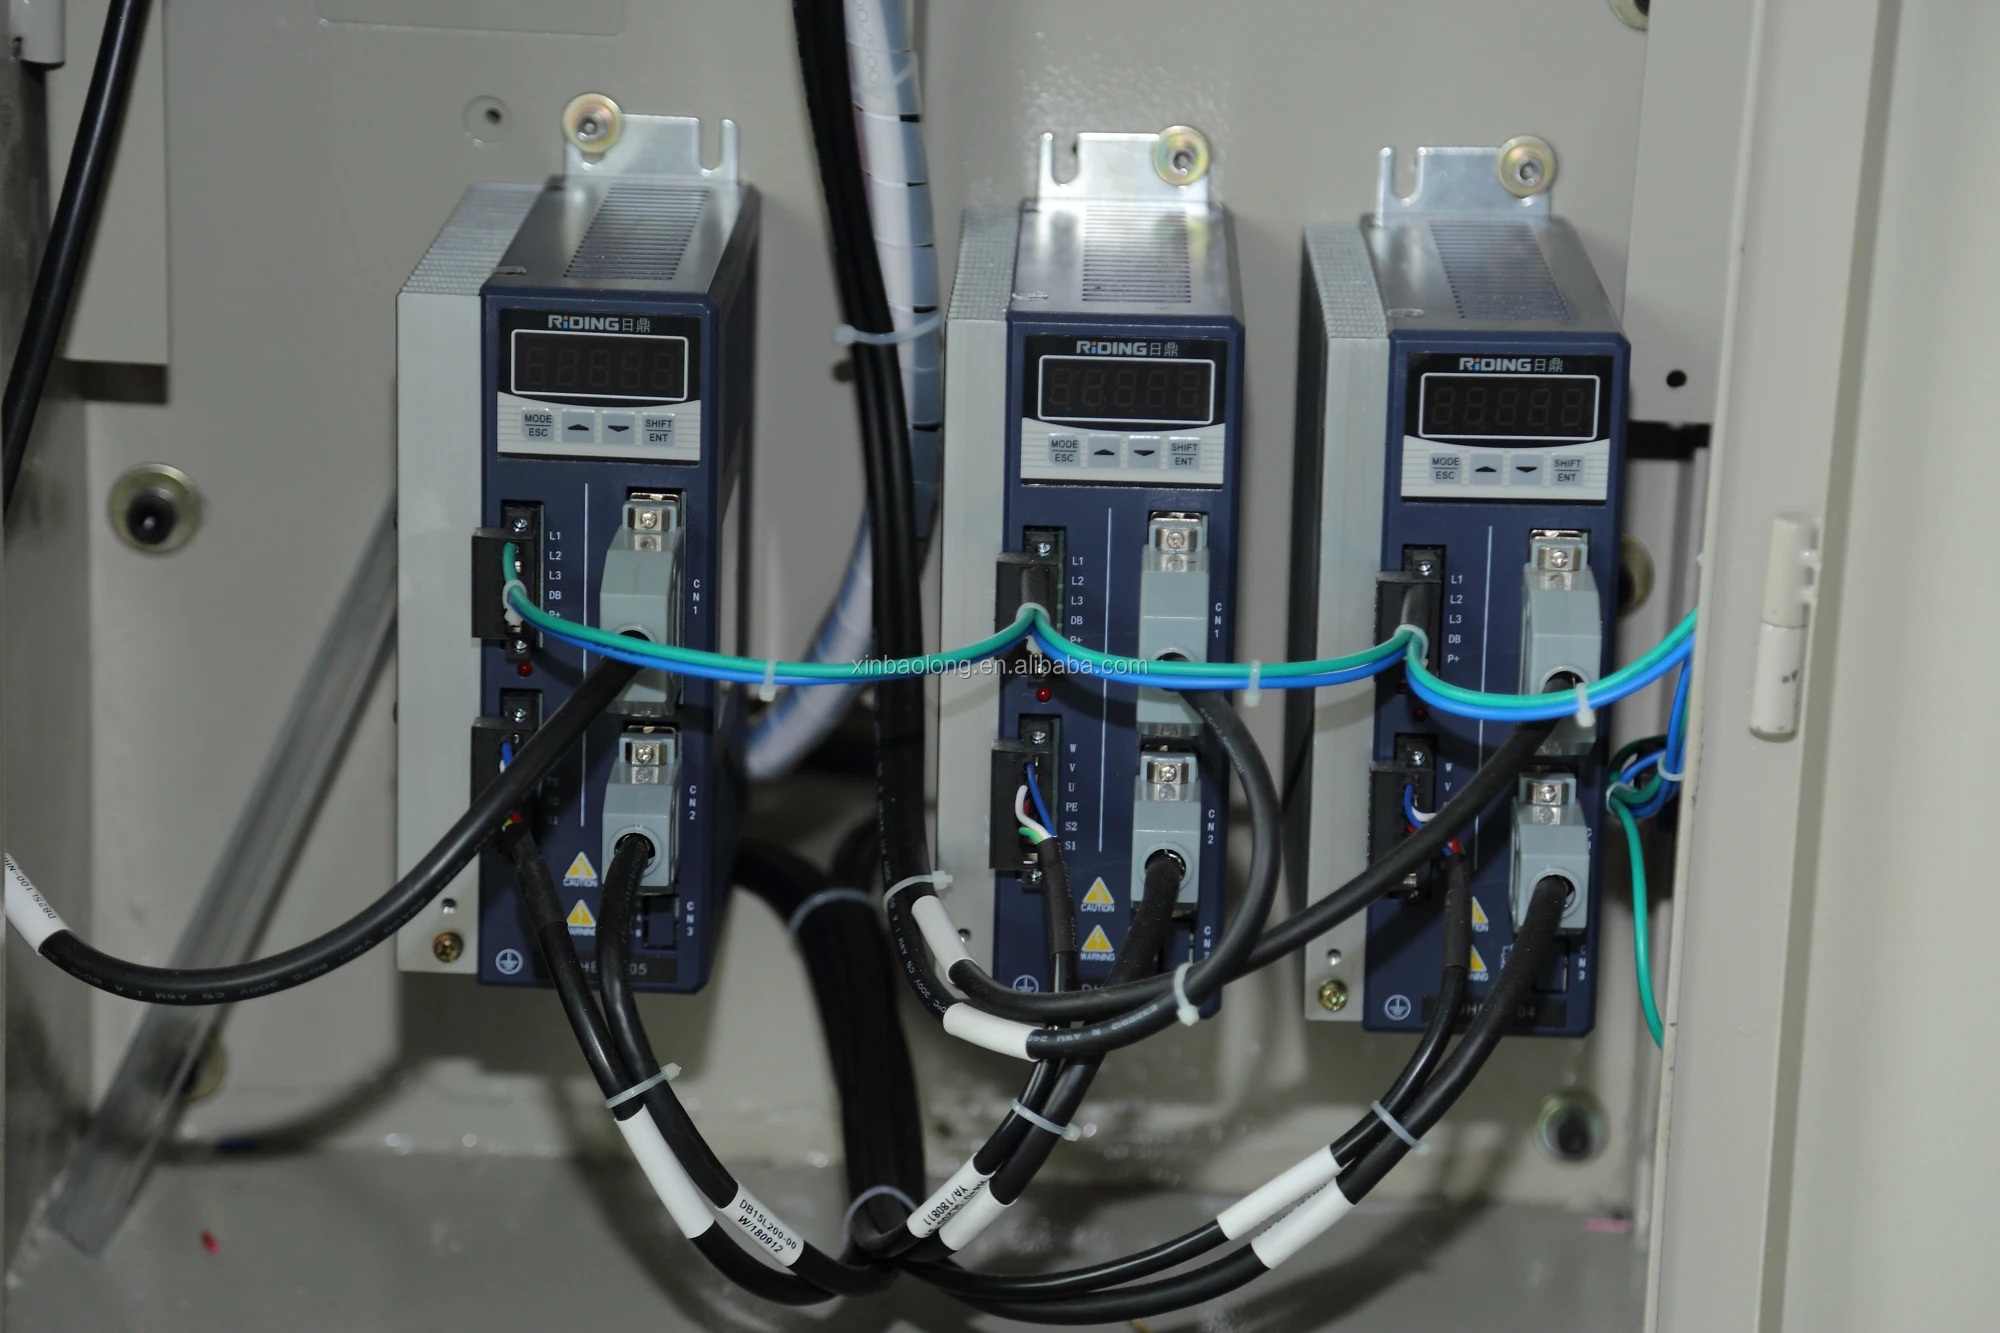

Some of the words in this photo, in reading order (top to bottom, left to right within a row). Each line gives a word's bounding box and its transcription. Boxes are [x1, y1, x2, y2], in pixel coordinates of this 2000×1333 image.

[524, 413, 552, 424] MODE
[645, 419, 672, 429] SHIFT
[528, 428, 548, 437] ESC
[649, 433, 668, 442] ENT
[1051, 439, 1078, 449] MODE
[1171, 443, 1198, 452] SHIFT
[1054, 453, 1073, 463] ESC
[1174, 457, 1193, 466] ENT
[1432, 457, 1460, 466] MODE
[1554, 458, 1582, 468] SHIFT
[1436, 471, 1455, 480] ESC
[1557, 473, 1576, 482] ENT
[549, 531, 561, 541] L1
[549, 551, 562, 561] L2
[1072, 556, 1084, 566] L1
[549, 571, 562, 580] L3
[1451, 575, 1463, 584] L1
[1071, 576, 1084, 586] L2
[549, 590, 562, 600] DB
[1450, 595, 1463, 604] L2
[1071, 596, 1083, 605] L3
[1070, 616, 1083, 625] DB
[1449, 615, 1462, 624] L3
[1448, 634, 1461, 644] DB
[1447, 654, 1460, 664] P+
[1065, 802, 1078, 812] PE
[1065, 822, 1077, 831] S2
[1065, 841, 1076, 850] S1
[563, 878, 598, 887] CAUTION
[1081, 903, 1115, 913] CAUTION
[1080, 952, 1115, 962] WARNING
[738, 1214, 784, 1254] W/180912
